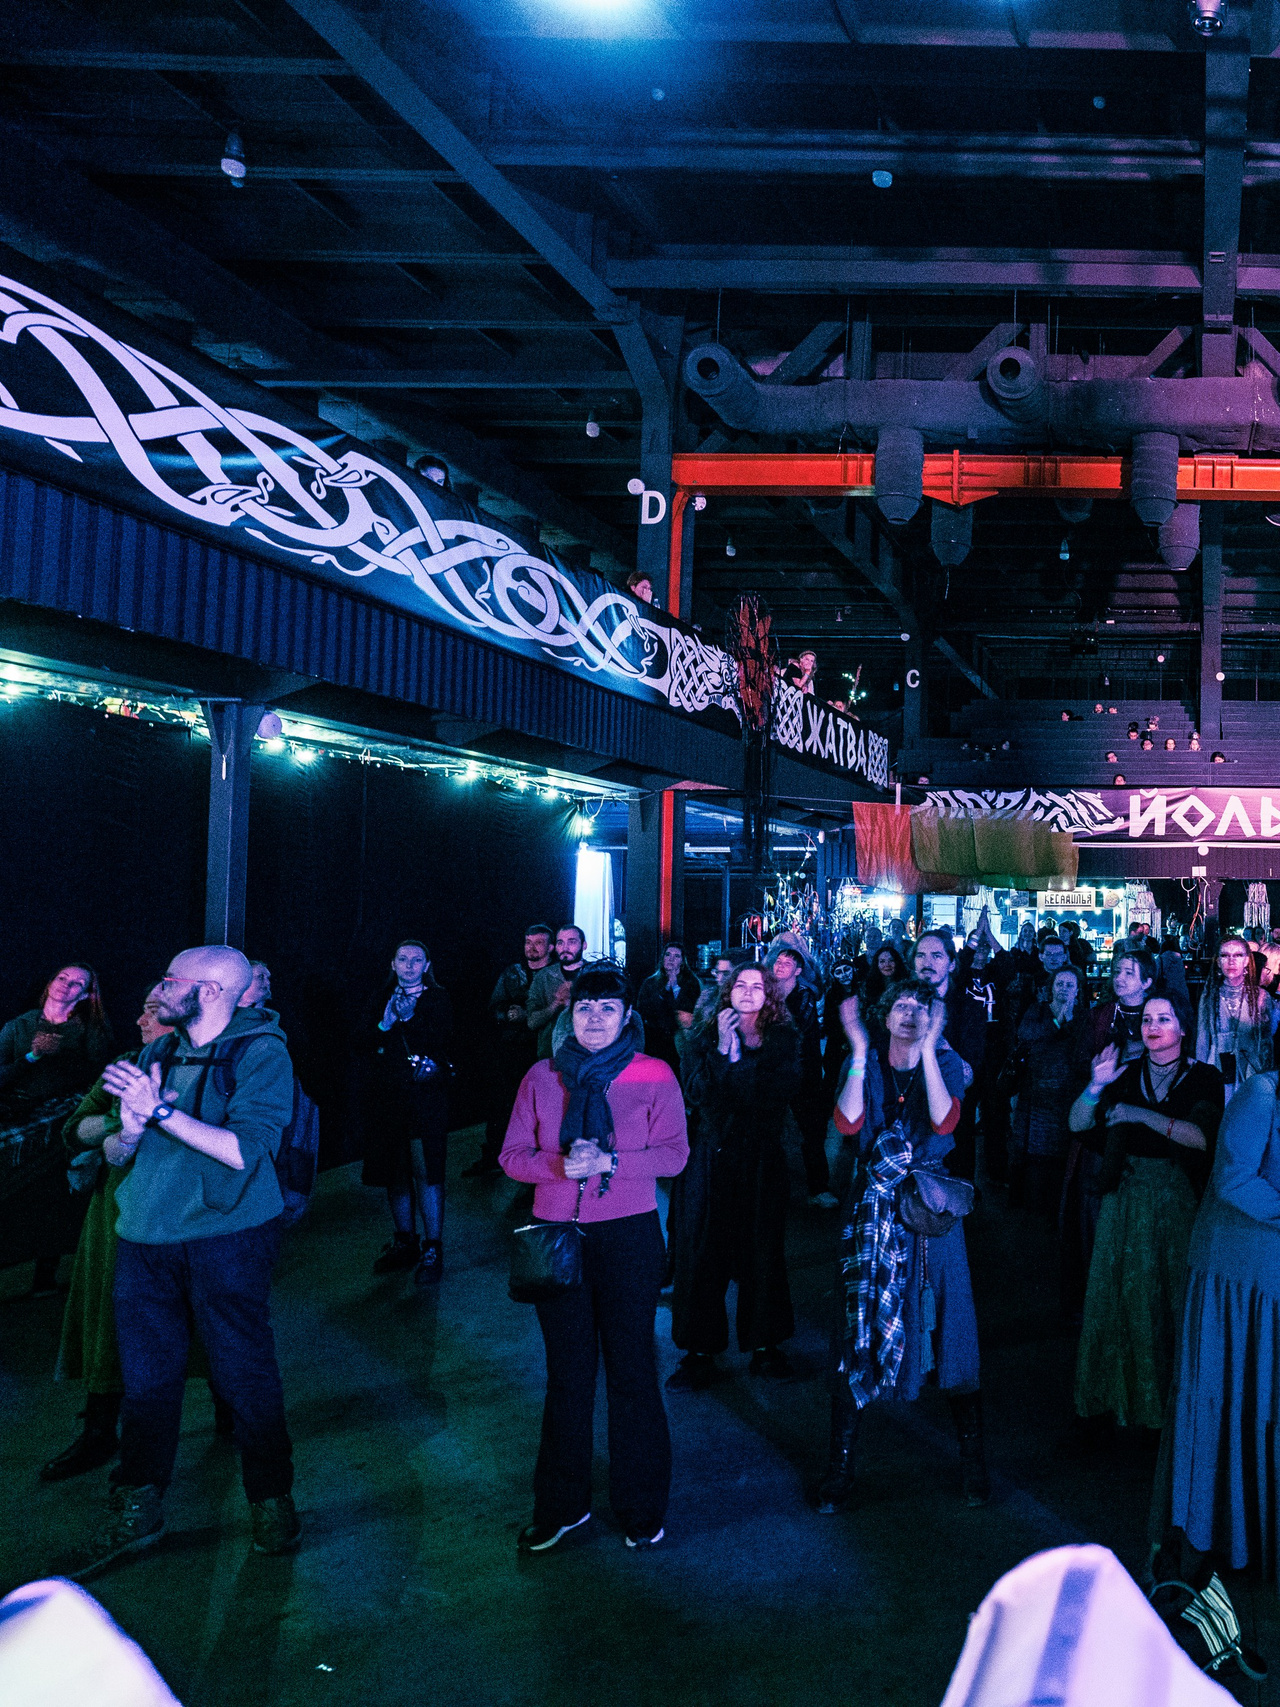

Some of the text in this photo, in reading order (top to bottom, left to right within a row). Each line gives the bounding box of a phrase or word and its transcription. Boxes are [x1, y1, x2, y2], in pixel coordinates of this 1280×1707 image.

[641, 490, 667, 525] D
[804, 699, 868, 777] ЖАТВА
[1044, 893, 1092, 905] КЕСАДИЛЬЯ
